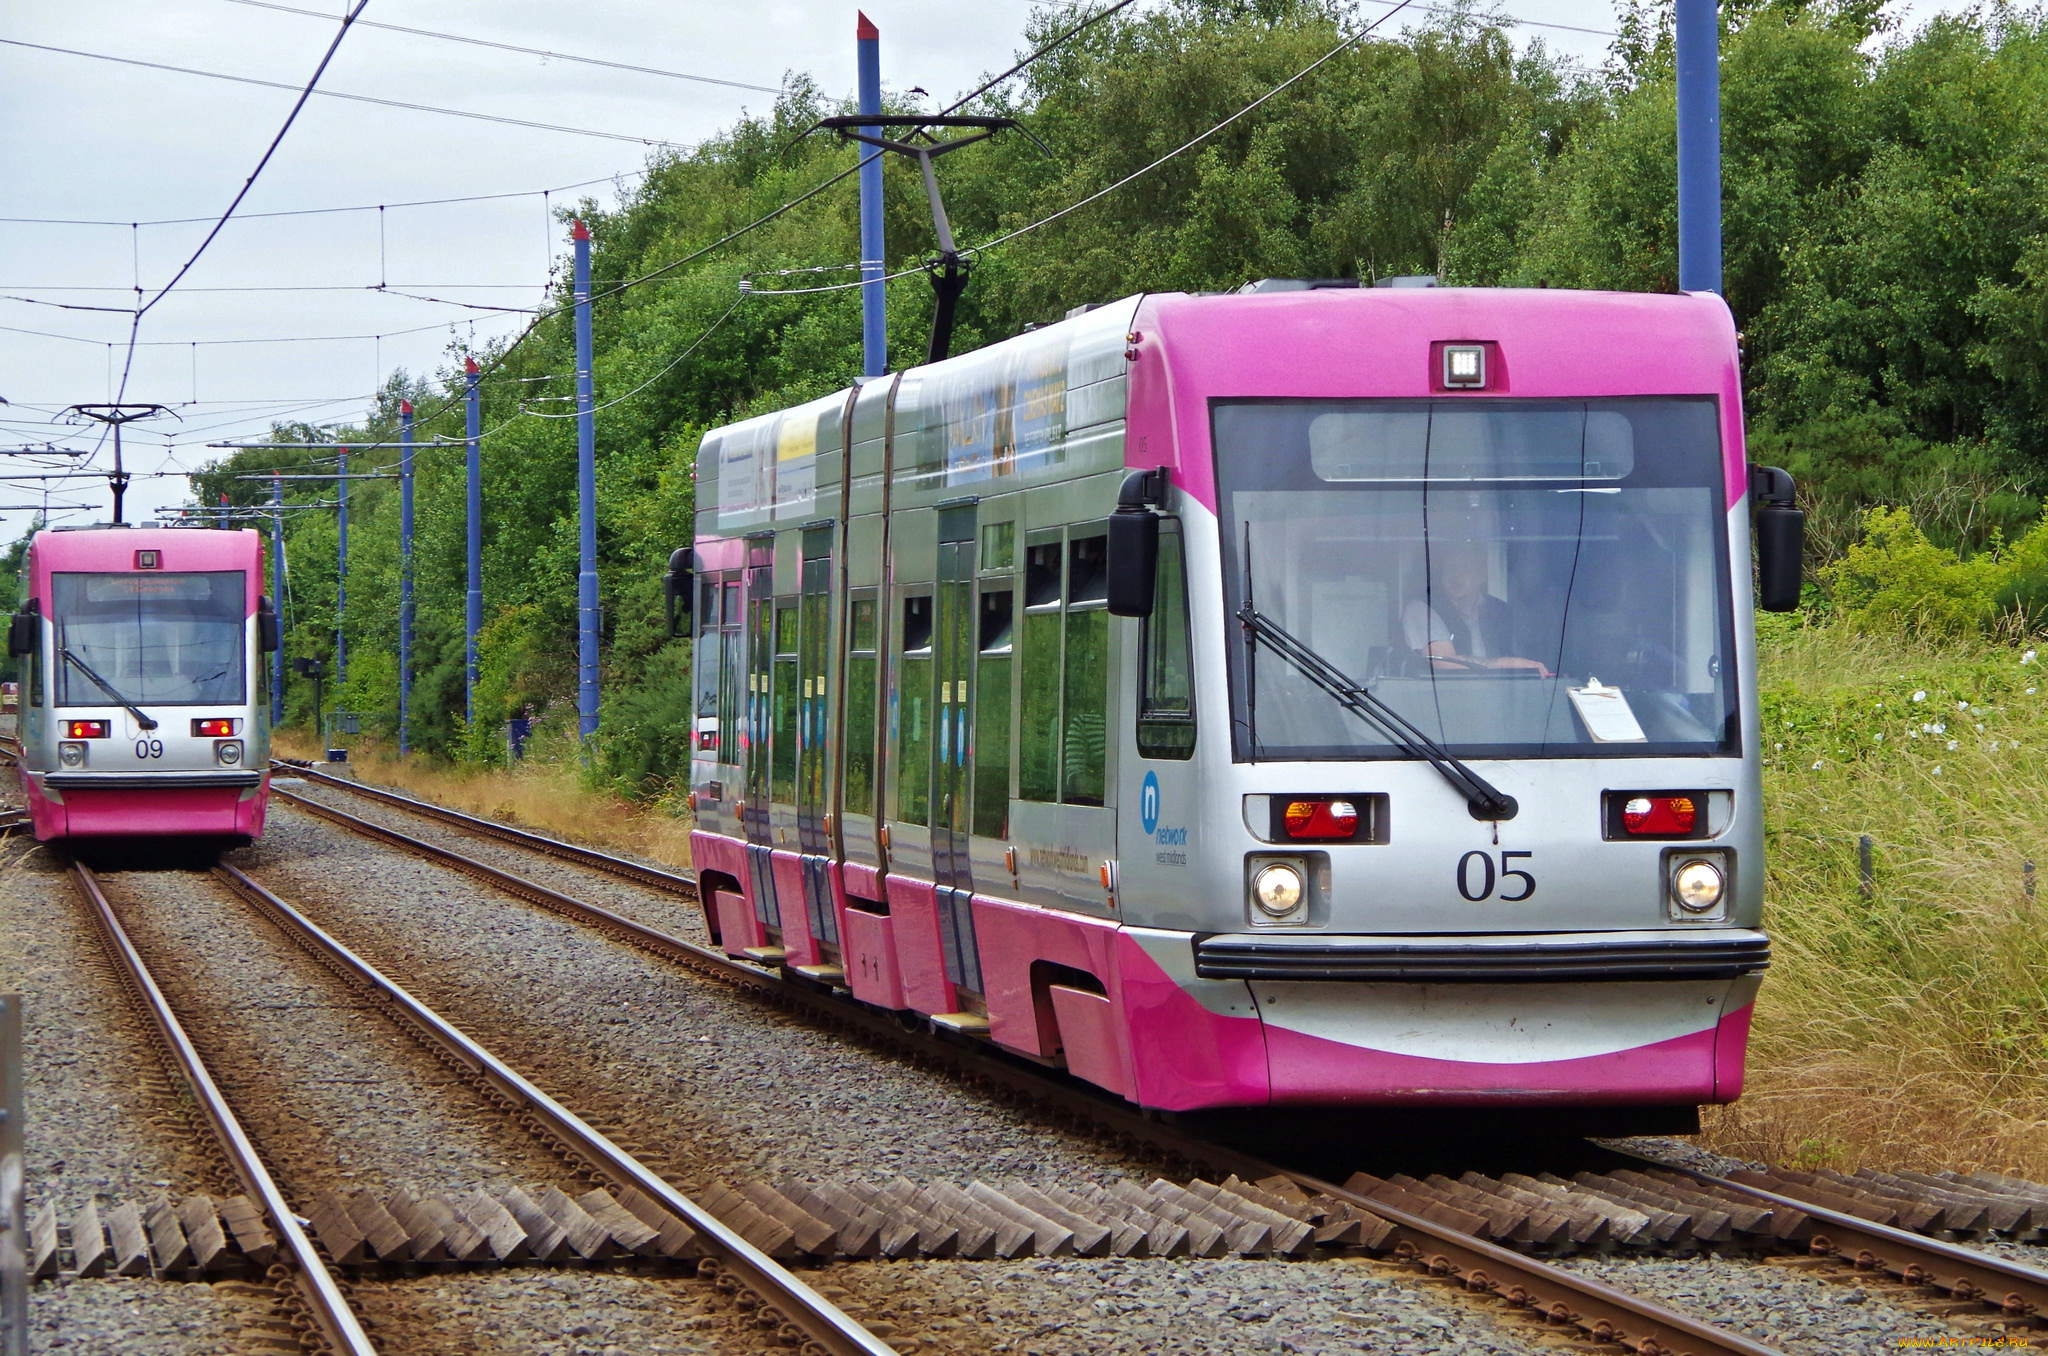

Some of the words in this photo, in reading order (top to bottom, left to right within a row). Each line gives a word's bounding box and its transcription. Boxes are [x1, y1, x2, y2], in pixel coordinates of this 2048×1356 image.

[1138, 436, 1148, 453] 05
[135, 739, 164, 759] 09
[1145, 785, 1156, 820] n
[1156, 825, 1188, 846] network
[1156, 851, 1166, 863] west
[1456, 850, 1537, 902] 05
